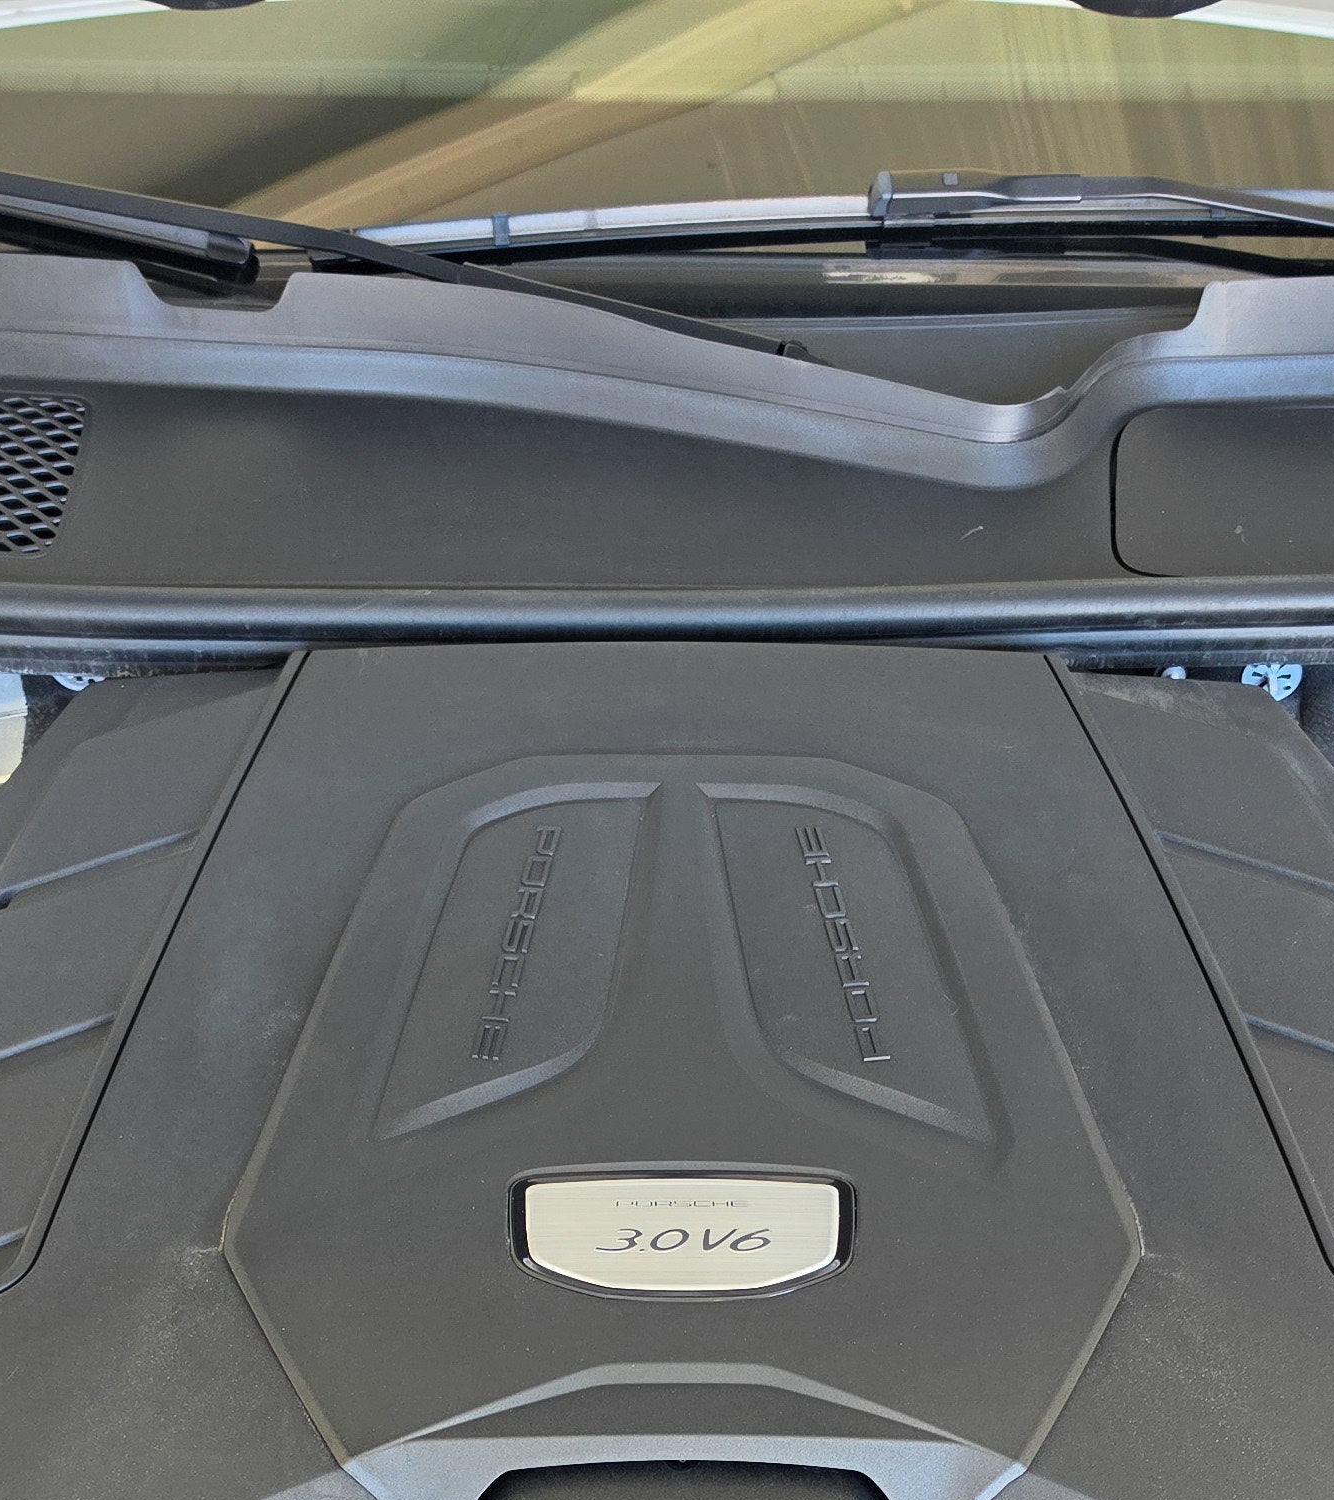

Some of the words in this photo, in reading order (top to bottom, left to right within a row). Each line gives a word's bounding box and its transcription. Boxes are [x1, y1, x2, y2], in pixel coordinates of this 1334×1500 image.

[471, 826, 562, 1060] PORSCHE
[795, 827, 891, 1062] PORSCHE
[595, 1228, 690, 1252] 3.0
[702, 1228, 772, 1251] V6
